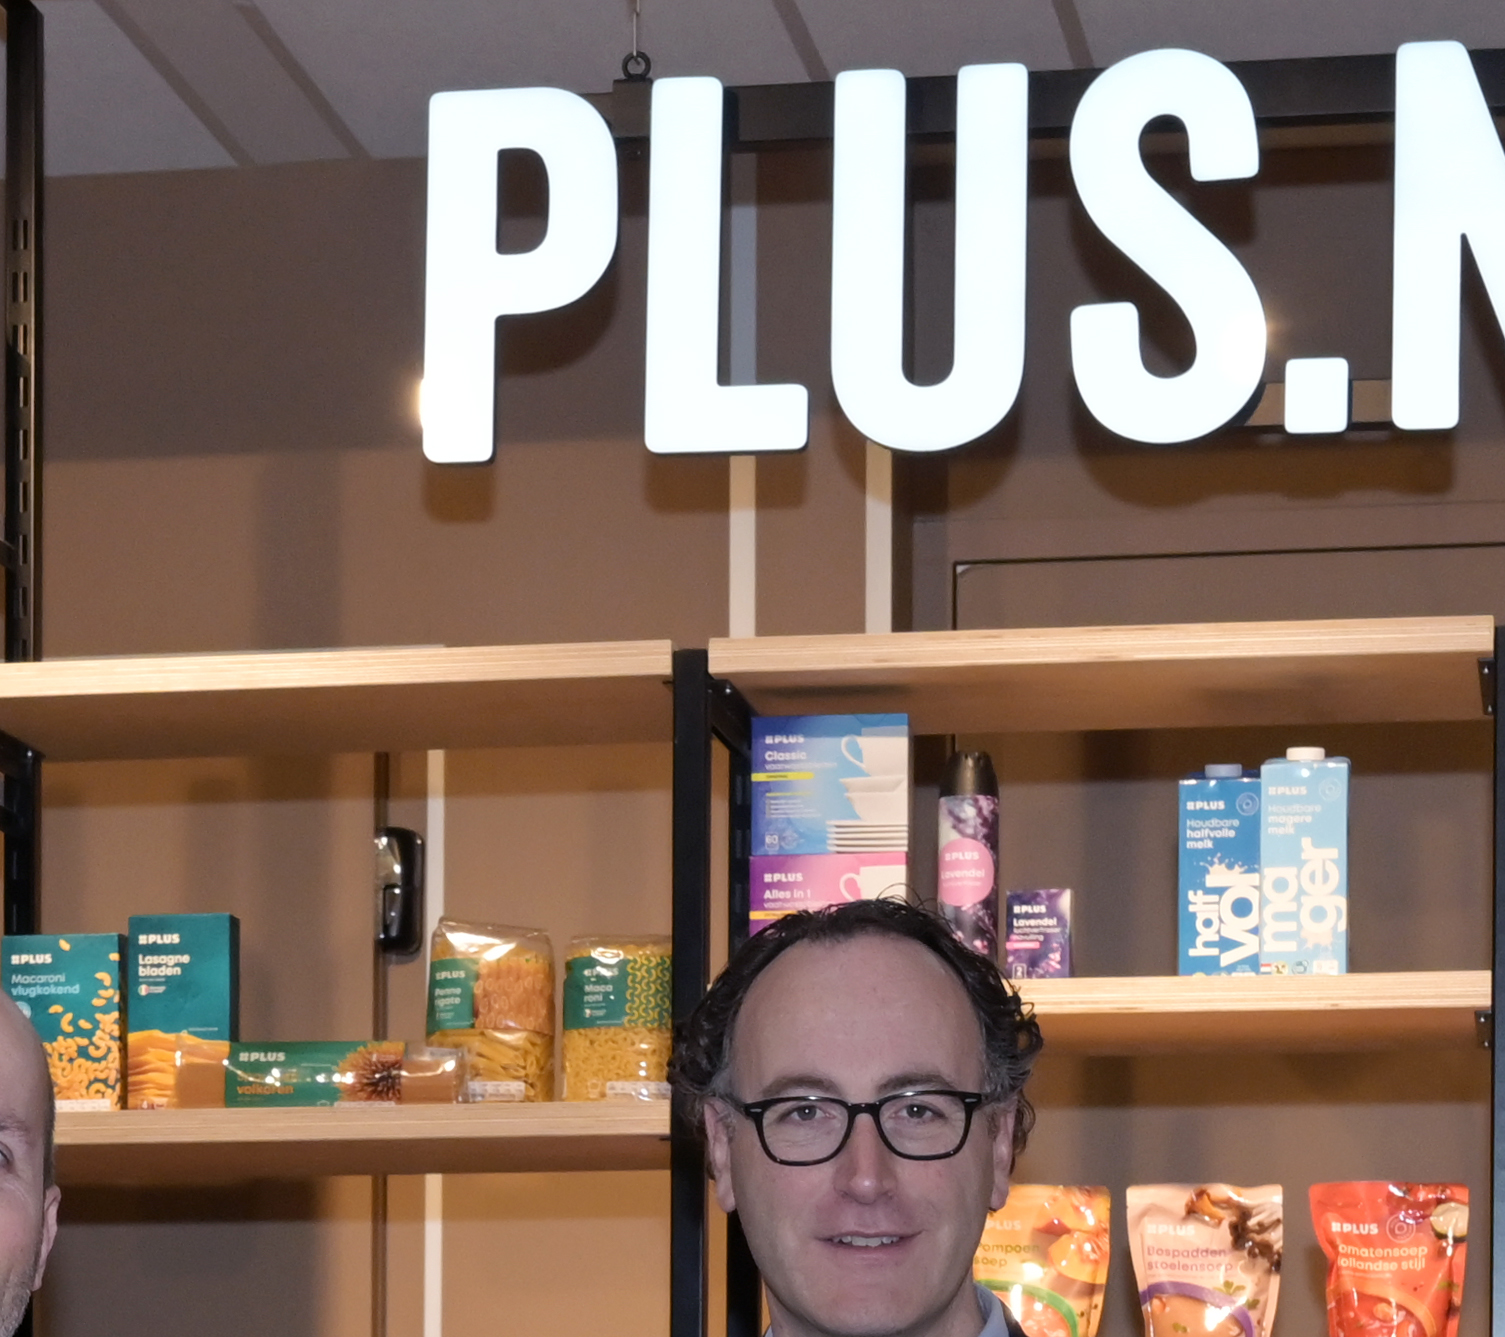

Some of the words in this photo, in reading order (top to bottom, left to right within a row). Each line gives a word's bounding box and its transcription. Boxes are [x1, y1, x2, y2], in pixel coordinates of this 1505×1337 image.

[775, 735, 804, 744] PLUS
[765, 751, 806, 761] Classic
[1278, 786, 1307, 795] PLUS
[1196, 802, 1225, 810] PLUS
[1187, 819, 1239, 828] Houdbare
[1268, 815, 1312, 824] magere
[1187, 828, 1235, 838] halfvolle
[1268, 825, 1295, 834] melk
[1187, 839, 1213, 848] melk
[952, 852, 979, 860] PLUS
[774, 873, 803, 882] PLUS
[1263, 867, 1298, 952] ma
[1300, 837, 1347, 933] ger
[1022, 905, 1046, 913] PLUS
[1013, 917, 1057, 926] Lavendel
[1188, 890, 1220, 957] half
[148, 934, 180, 944] PLUS
[21, 954, 52, 964] PLUS
[139, 954, 190, 966] Lasagne
[139, 966, 181, 976] bladen
[12, 974, 65, 984] Macaroni
[12, 984, 80, 996] vlugkokend
[585, 984, 613, 992] Maca
[251, 1051, 285, 1061] PLUS
[1158, 1224, 1195, 1235] PLUS
[1342, 1222, 1379, 1234] PLUS
